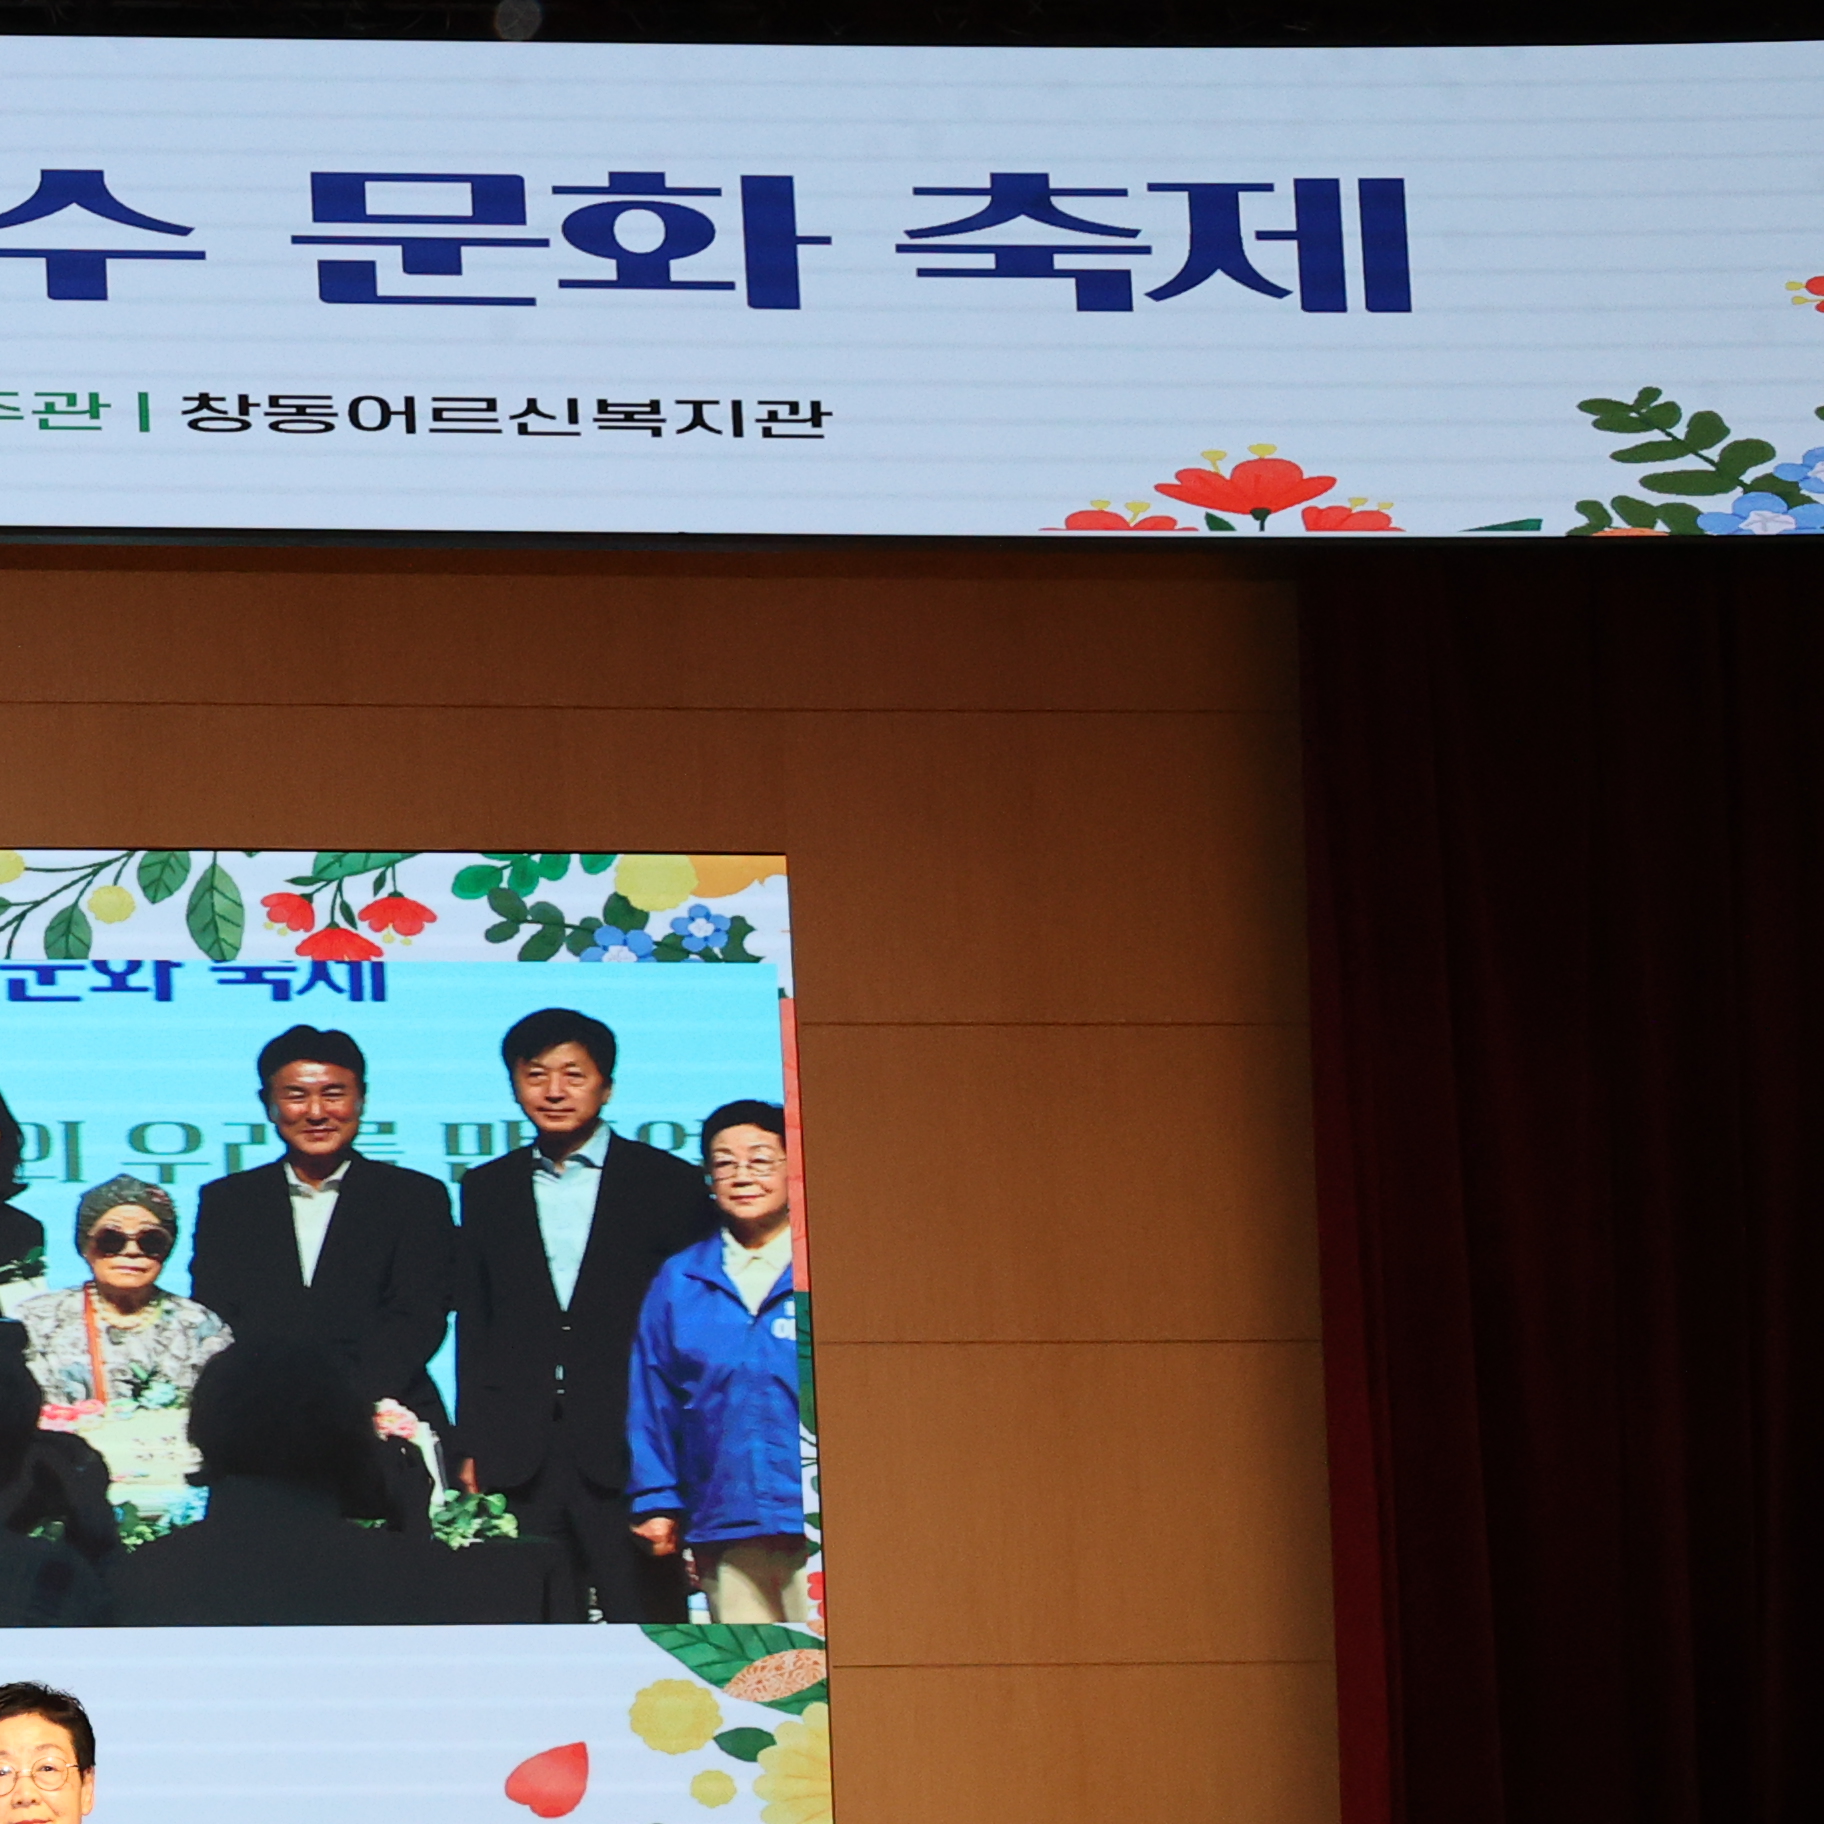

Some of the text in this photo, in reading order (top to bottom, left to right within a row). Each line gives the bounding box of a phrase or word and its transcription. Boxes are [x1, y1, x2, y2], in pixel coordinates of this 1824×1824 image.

[289, 170, 832, 311] 문화
[894, 171, 1413, 314] 축제
[180, 391, 835, 440] 창동어르신복지관
